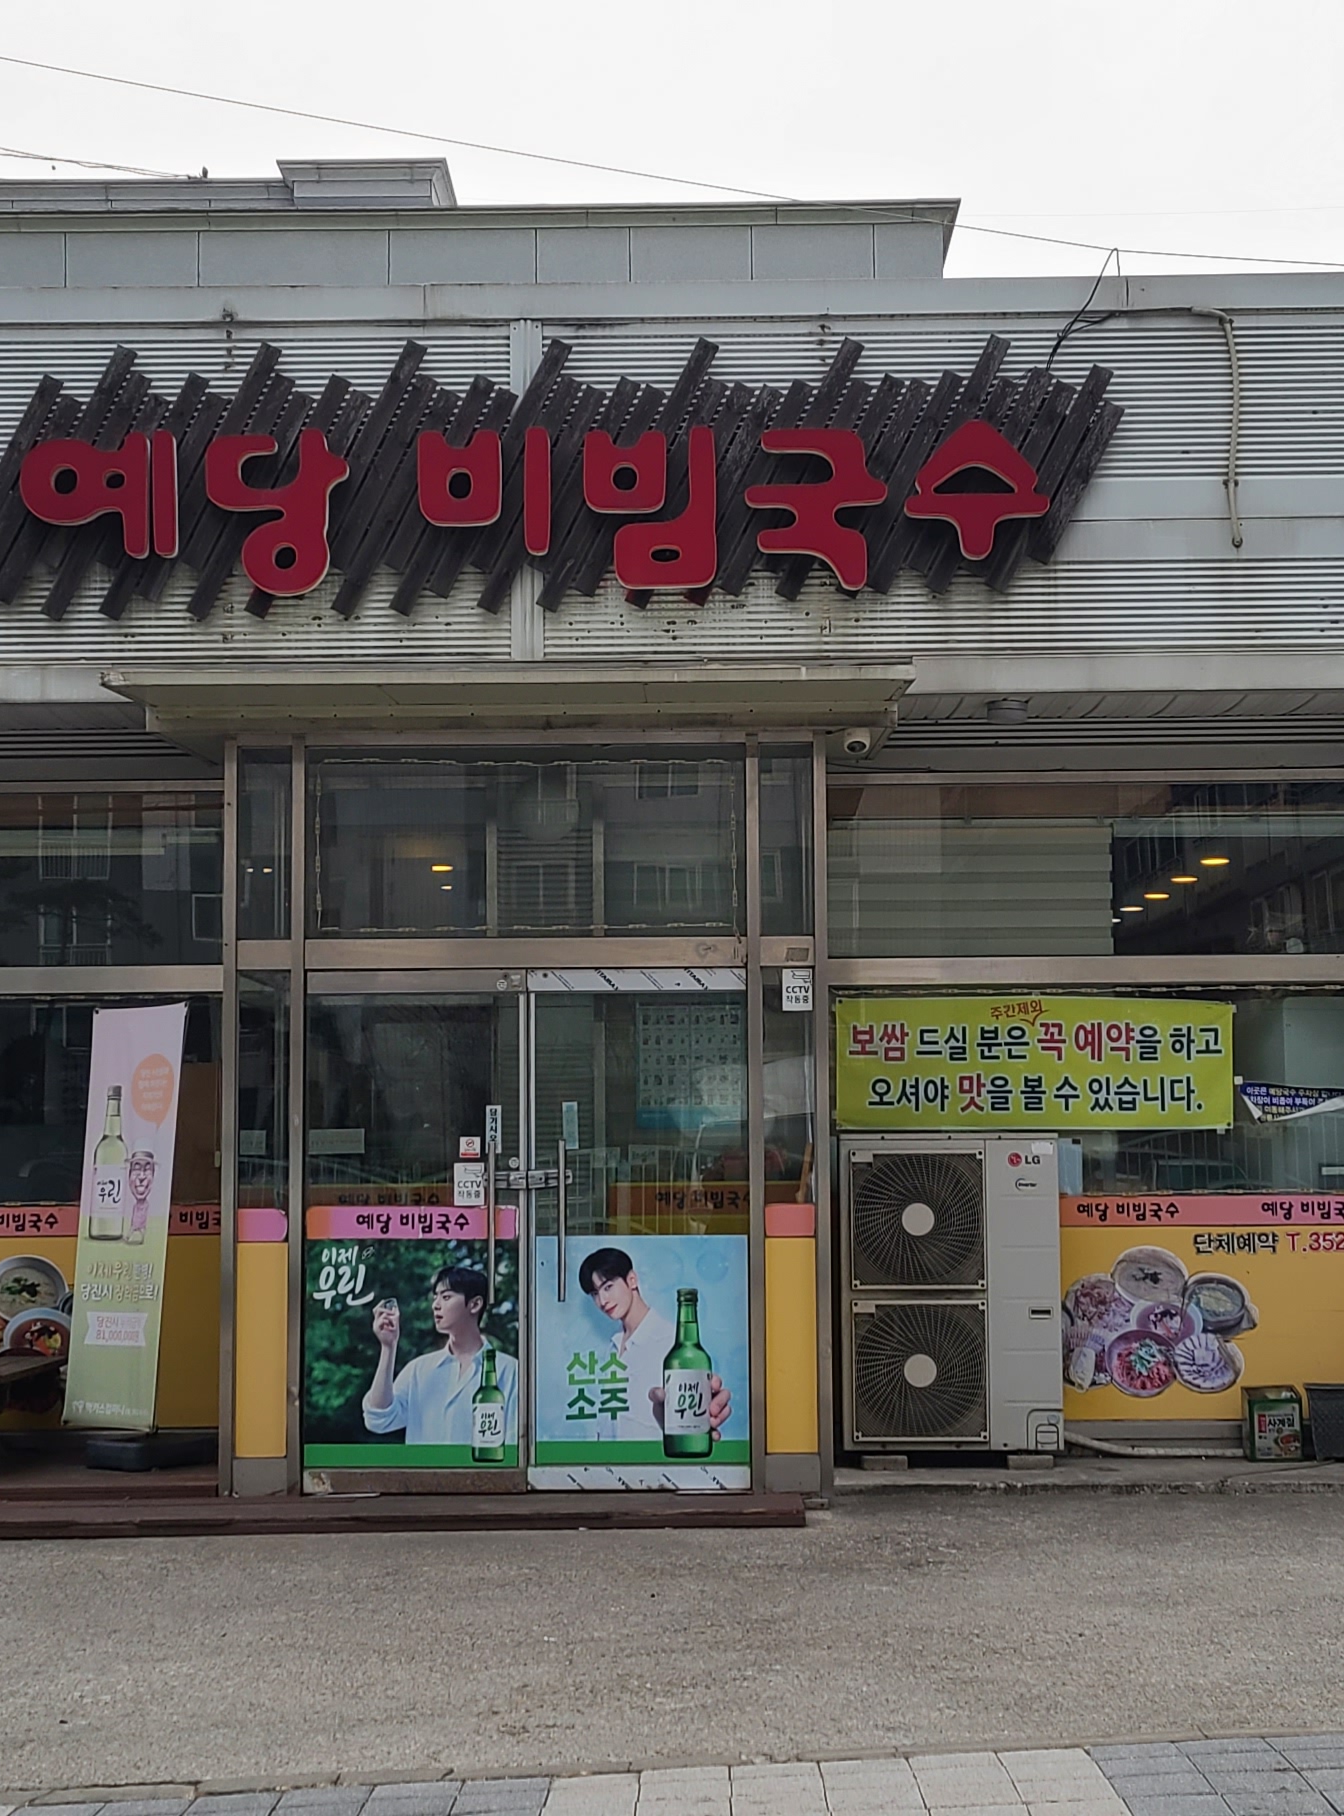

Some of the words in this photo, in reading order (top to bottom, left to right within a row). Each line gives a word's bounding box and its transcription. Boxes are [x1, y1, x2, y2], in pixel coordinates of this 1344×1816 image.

[20, 427, 348, 595] 예당
[419, 419, 1050, 591] 비빔국수
[785, 985, 810, 994] CCTV
[990, 1000, 1044, 1019] 주간제외
[848, 1022, 909, 1062] 보쌈
[915, 1026, 969, 1062] 드실
[976, 1025, 1030, 1060] 분은
[1036, 1022, 1067, 1061] 꼭
[1074, 1022, 1162, 1062] 예약을
[1169, 1025, 1223, 1060] 하고
[868, 1076, 949, 1111] 오셔야
[958, 1073, 1013, 1113] 맛을
[1019, 1075, 1047, 1111] 볼
[1053, 1075, 1080, 1111] 수
[1088, 1075, 1203, 1111] 있습니다.
[488, 1108, 499, 1143] 당기시오
[1024, 1155, 1041, 1165] LG
[99, 1179, 121, 1203] 우린
[457, 1180, 482, 1189] CCTV
[458, 1190, 481, 1199] 작동중
[1076, 1202, 1109, 1222] 예당
[1116, 1201, 1180, 1221] 비빔국수
[1261, 1202, 1294, 1221] 예당
[355, 1213, 392, 1235] 예당
[399, 1212, 470, 1235] 비빔국수
[1193, 1232, 1279, 1255] 단체예약
[321, 1245, 359, 1266] 이제
[81, 1283, 113, 1301] 당진시
[312, 1263, 375, 1310] 우린
[566, 1350, 629, 1386] 산소
[678, 1381, 699, 1394] 이제
[565, 1387, 630, 1420] 소주
[674, 1392, 707, 1419] 우린
[478, 1419, 502, 1438] 우린
